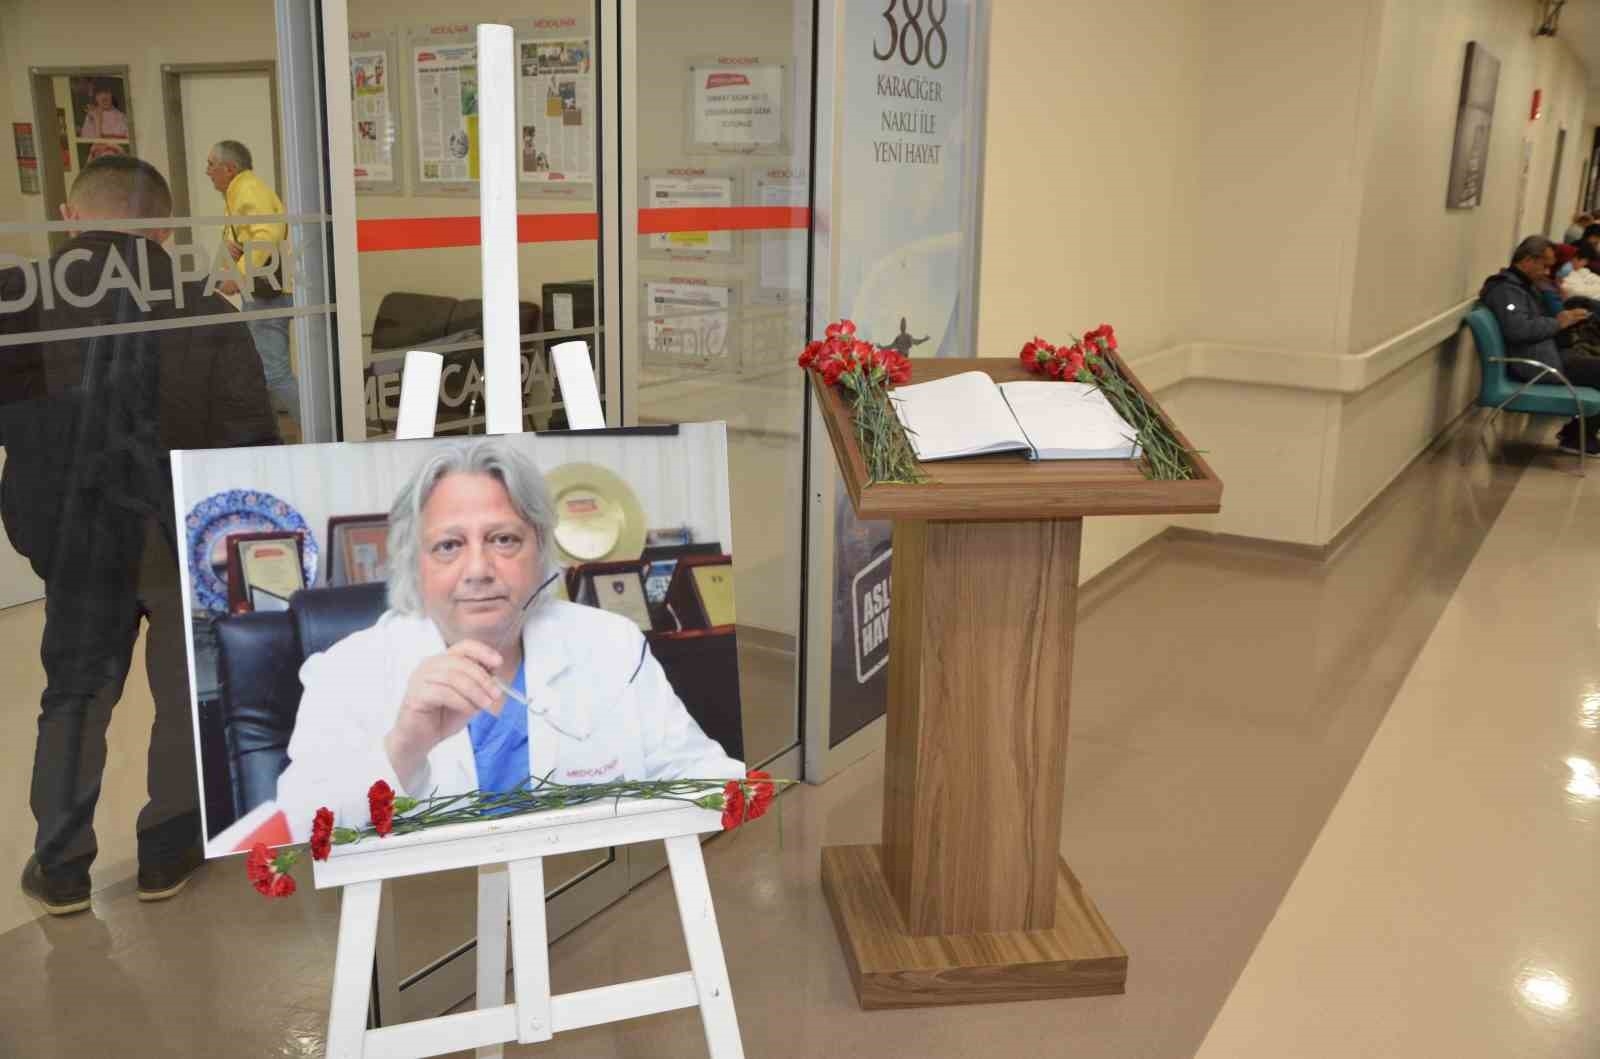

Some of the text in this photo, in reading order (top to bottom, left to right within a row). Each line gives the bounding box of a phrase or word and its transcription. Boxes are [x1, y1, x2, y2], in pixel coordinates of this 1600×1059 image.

[873, 0, 948, 69] 388
[876, 74, 943, 102] KARACİĞER
[873, 138, 942, 165] YENİ HAYAT
